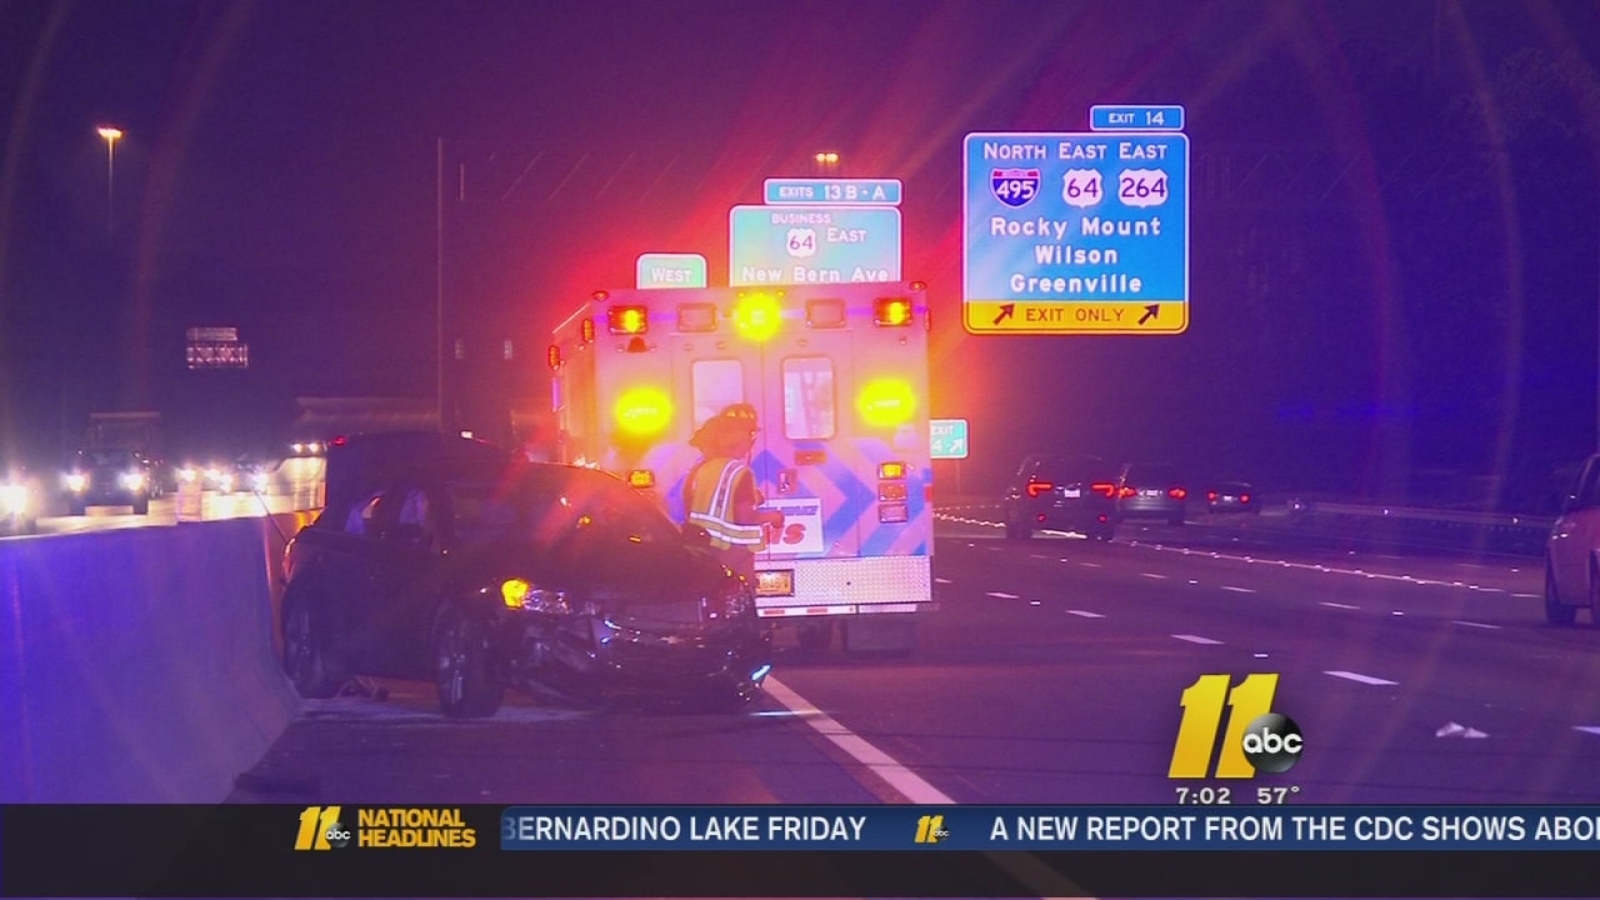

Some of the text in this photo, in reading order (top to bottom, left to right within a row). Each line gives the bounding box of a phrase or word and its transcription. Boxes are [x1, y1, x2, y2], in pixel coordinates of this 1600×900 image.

[1108, 111, 1165, 126] EXIT 14
[984, 143, 1167, 159] NORTH EAST EAST
[779, 186, 814, 198] EXITS
[996, 180, 1035, 199] 495
[1067, 177, 1098, 198] 64
[1121, 177, 1166, 198] 264
[771, 213, 831, 224] BUSINESS
[827, 229, 867, 242] EAST
[990, 217, 1161, 240] Rocky Mount
[789, 234, 813, 250] 64
[1035, 245, 1118, 265] Wilson
[650, 267, 693, 283] WEST
[742, 267, 889, 282] New Bern Ave
[1010, 274, 1142, 292] Greenville
[1025, 309, 1124, 321] EXIT ONLY
